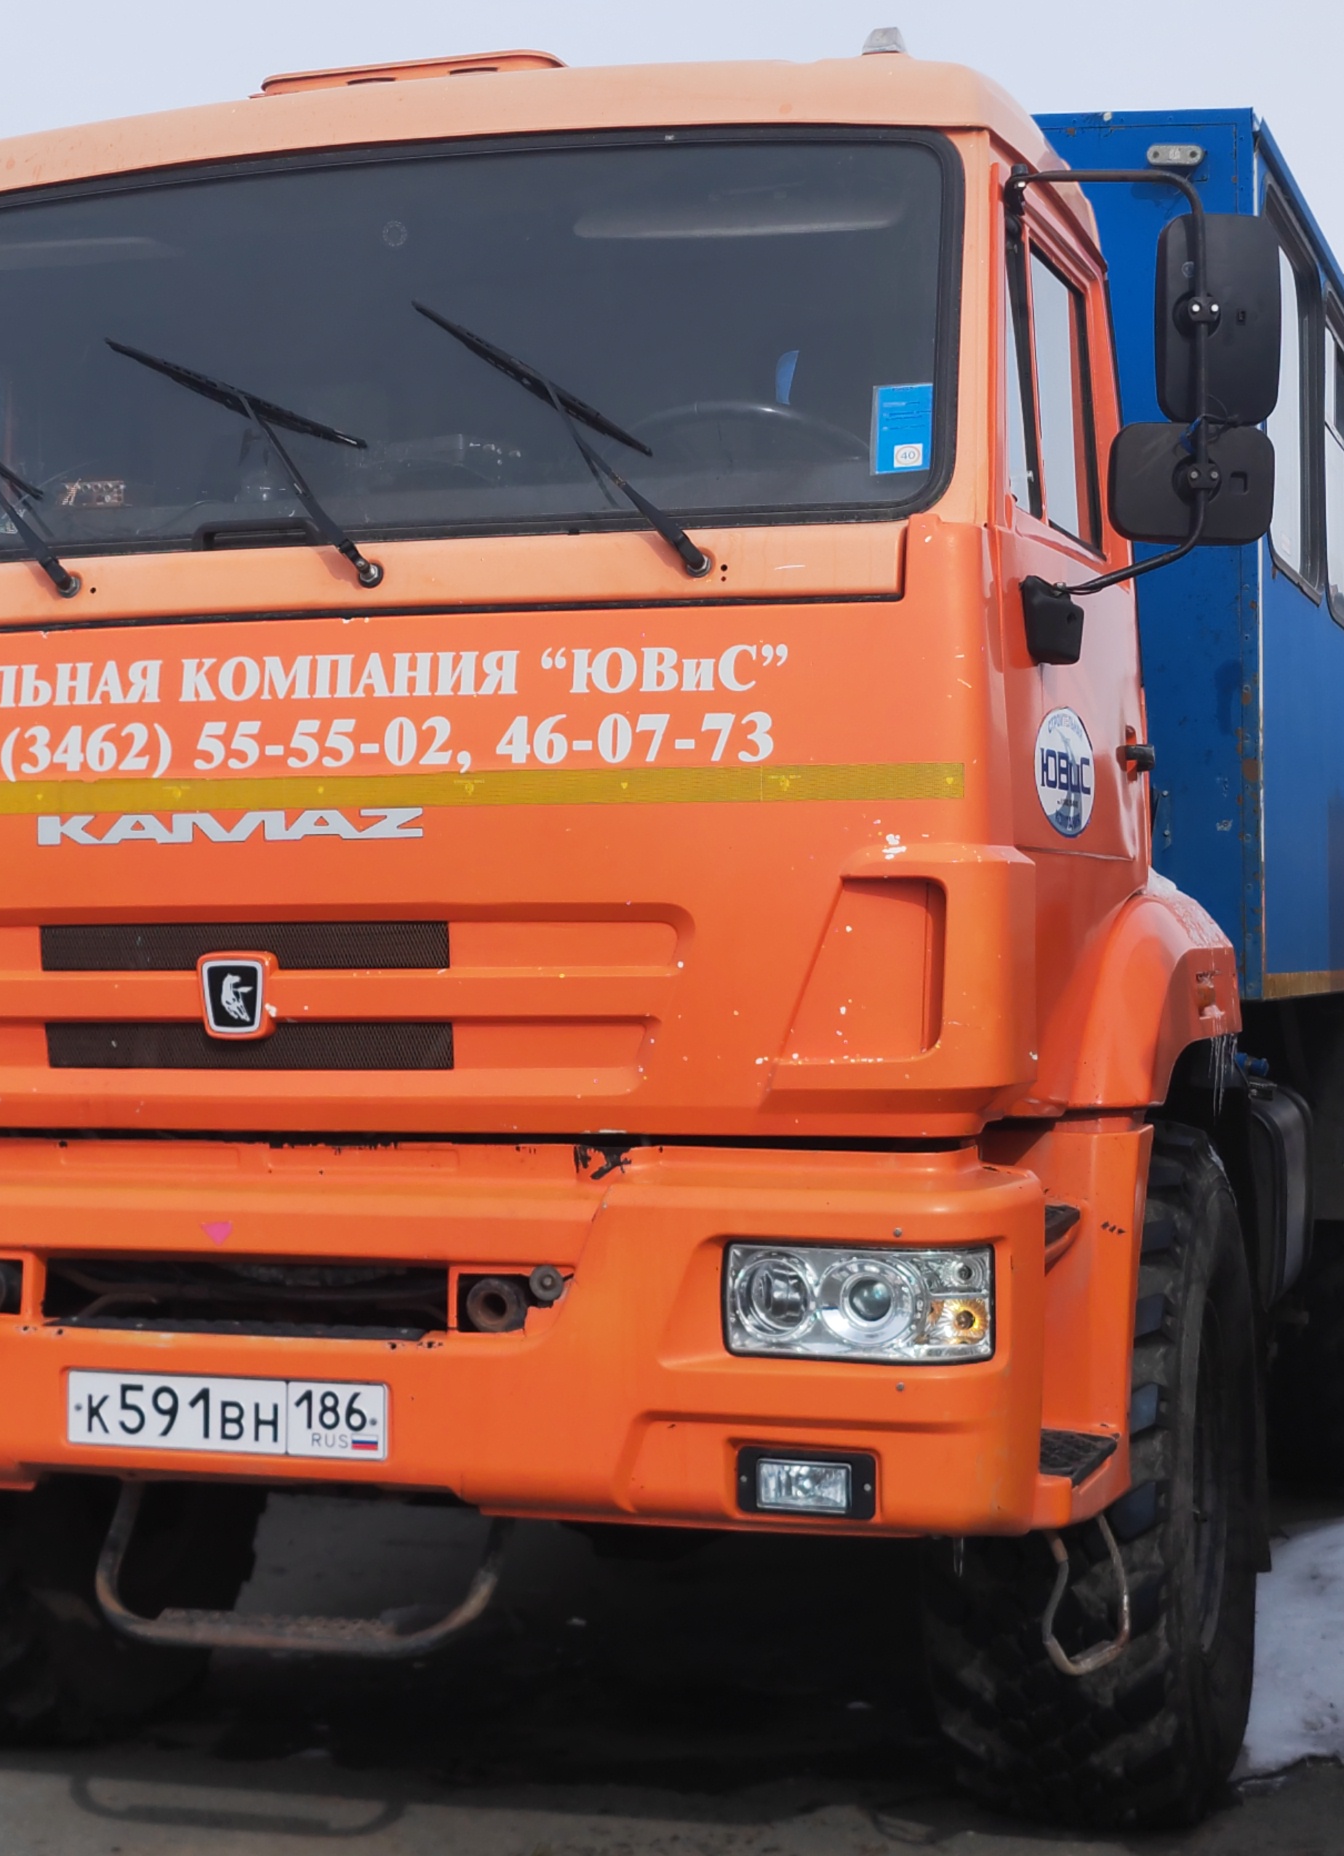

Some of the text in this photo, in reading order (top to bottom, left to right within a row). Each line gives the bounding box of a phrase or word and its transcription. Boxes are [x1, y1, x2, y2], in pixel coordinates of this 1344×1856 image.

[900, 450, 916, 460] 40
[179, 650, 520, 702] КОМПАНИЯ
[0, 723, 172, 782] (3462)
[194, 716, 472, 774] 55-55-02,
[496, 711, 776, 765] 46-07-73
[37, 807, 423, 846] KAMAZ
[87, 1384, 367, 1443] К591ВН 186
[311, 1433, 349, 1448] RUS
